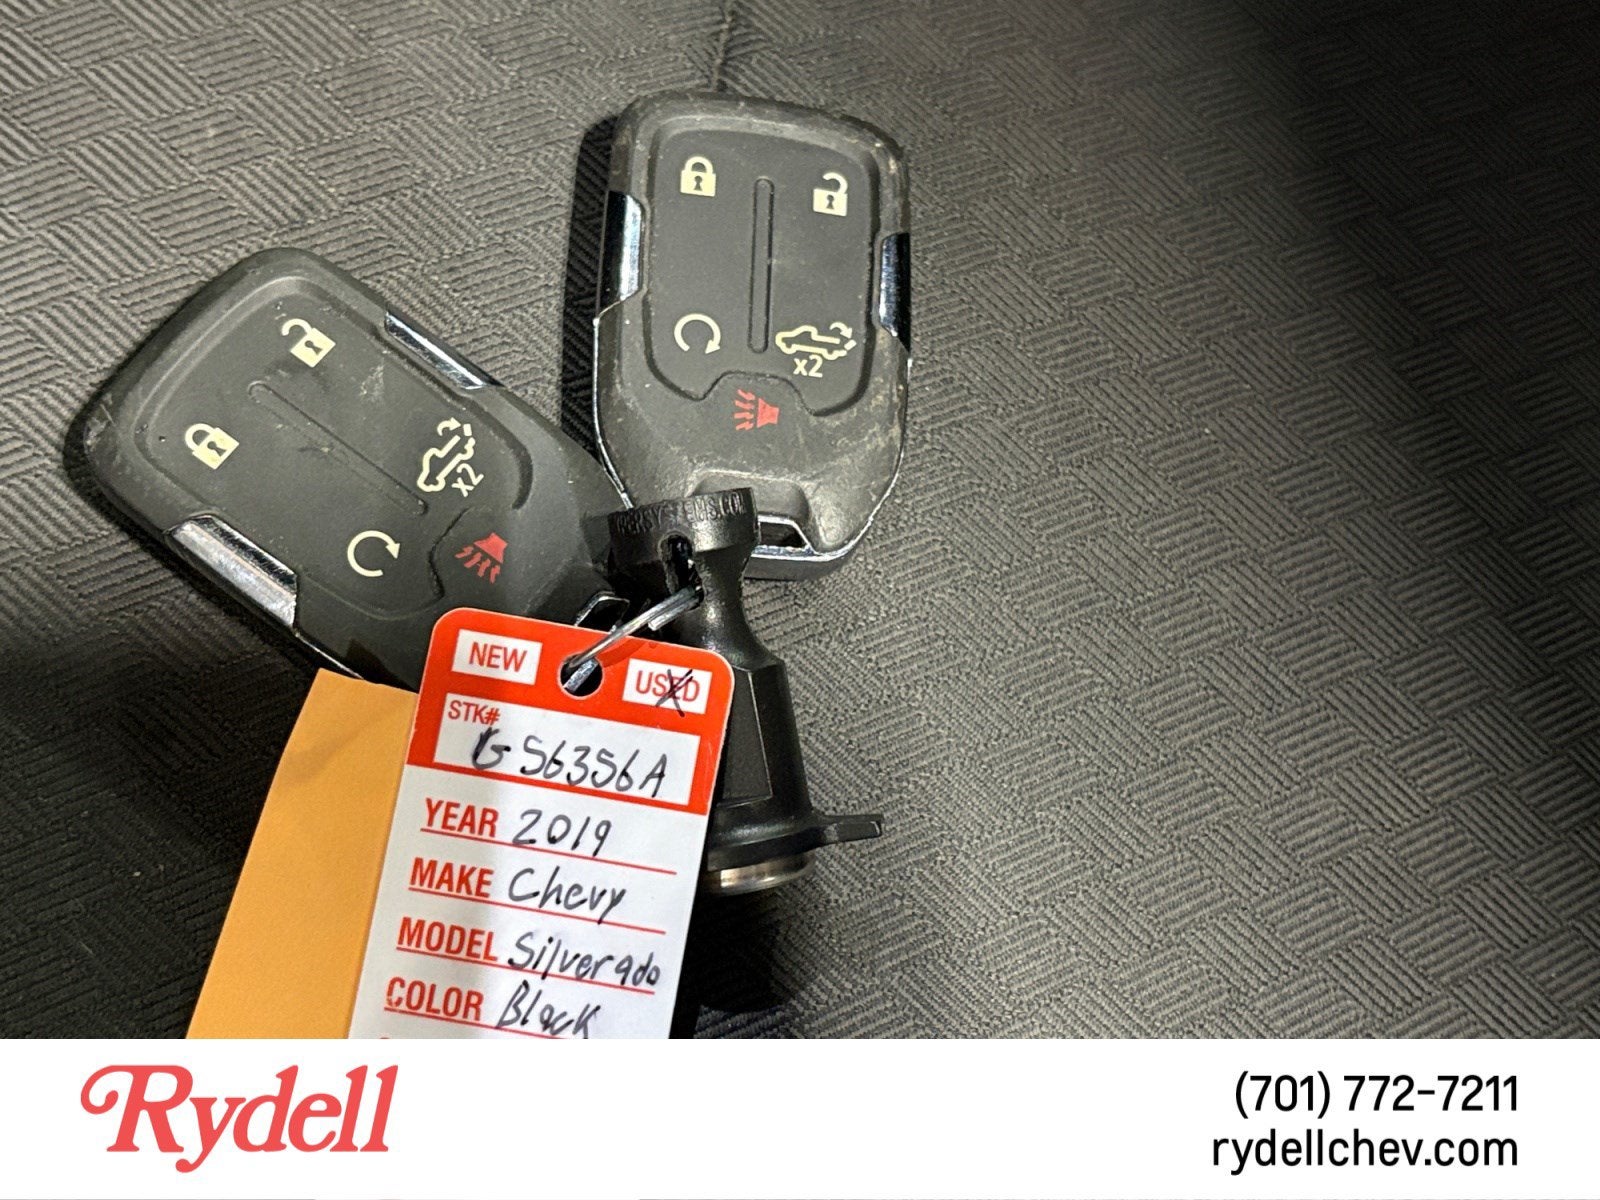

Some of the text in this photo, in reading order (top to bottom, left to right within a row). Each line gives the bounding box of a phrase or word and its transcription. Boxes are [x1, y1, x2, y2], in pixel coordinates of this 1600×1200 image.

[793, 354, 823, 378] x2
[451, 462, 485, 498] x2
[468, 641, 527, 673] NEW
[447, 699, 500, 726] STK#
[424, 797, 499, 838] YEAR
[511, 808, 612, 857] 2019
[409, 857, 495, 898] MAKE
[507, 866, 627, 925] Chevy
[397, 916, 498, 962] MODEL
[507, 932, 662, 987] Silverado
[385, 976, 484, 1022] COLOR
[495, 979, 601, 1039] Black
